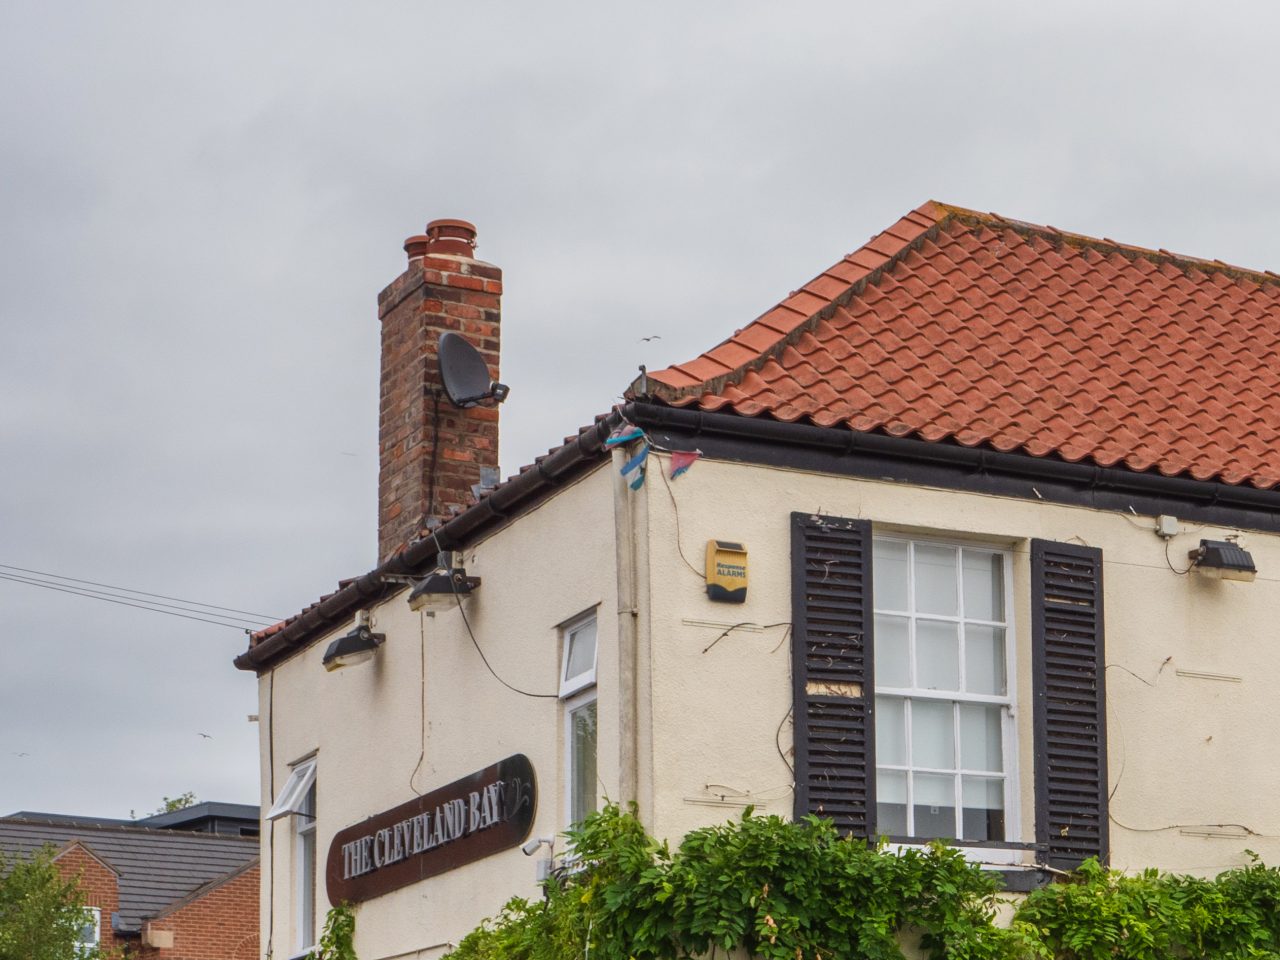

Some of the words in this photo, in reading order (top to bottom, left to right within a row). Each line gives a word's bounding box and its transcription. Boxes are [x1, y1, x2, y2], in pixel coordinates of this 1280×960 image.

[717, 568, 746, 578] ALARMS
[342, 835, 375, 880] THE
[374, 798, 466, 867] CLEVELAND
[469, 780, 505, 833] BAY
